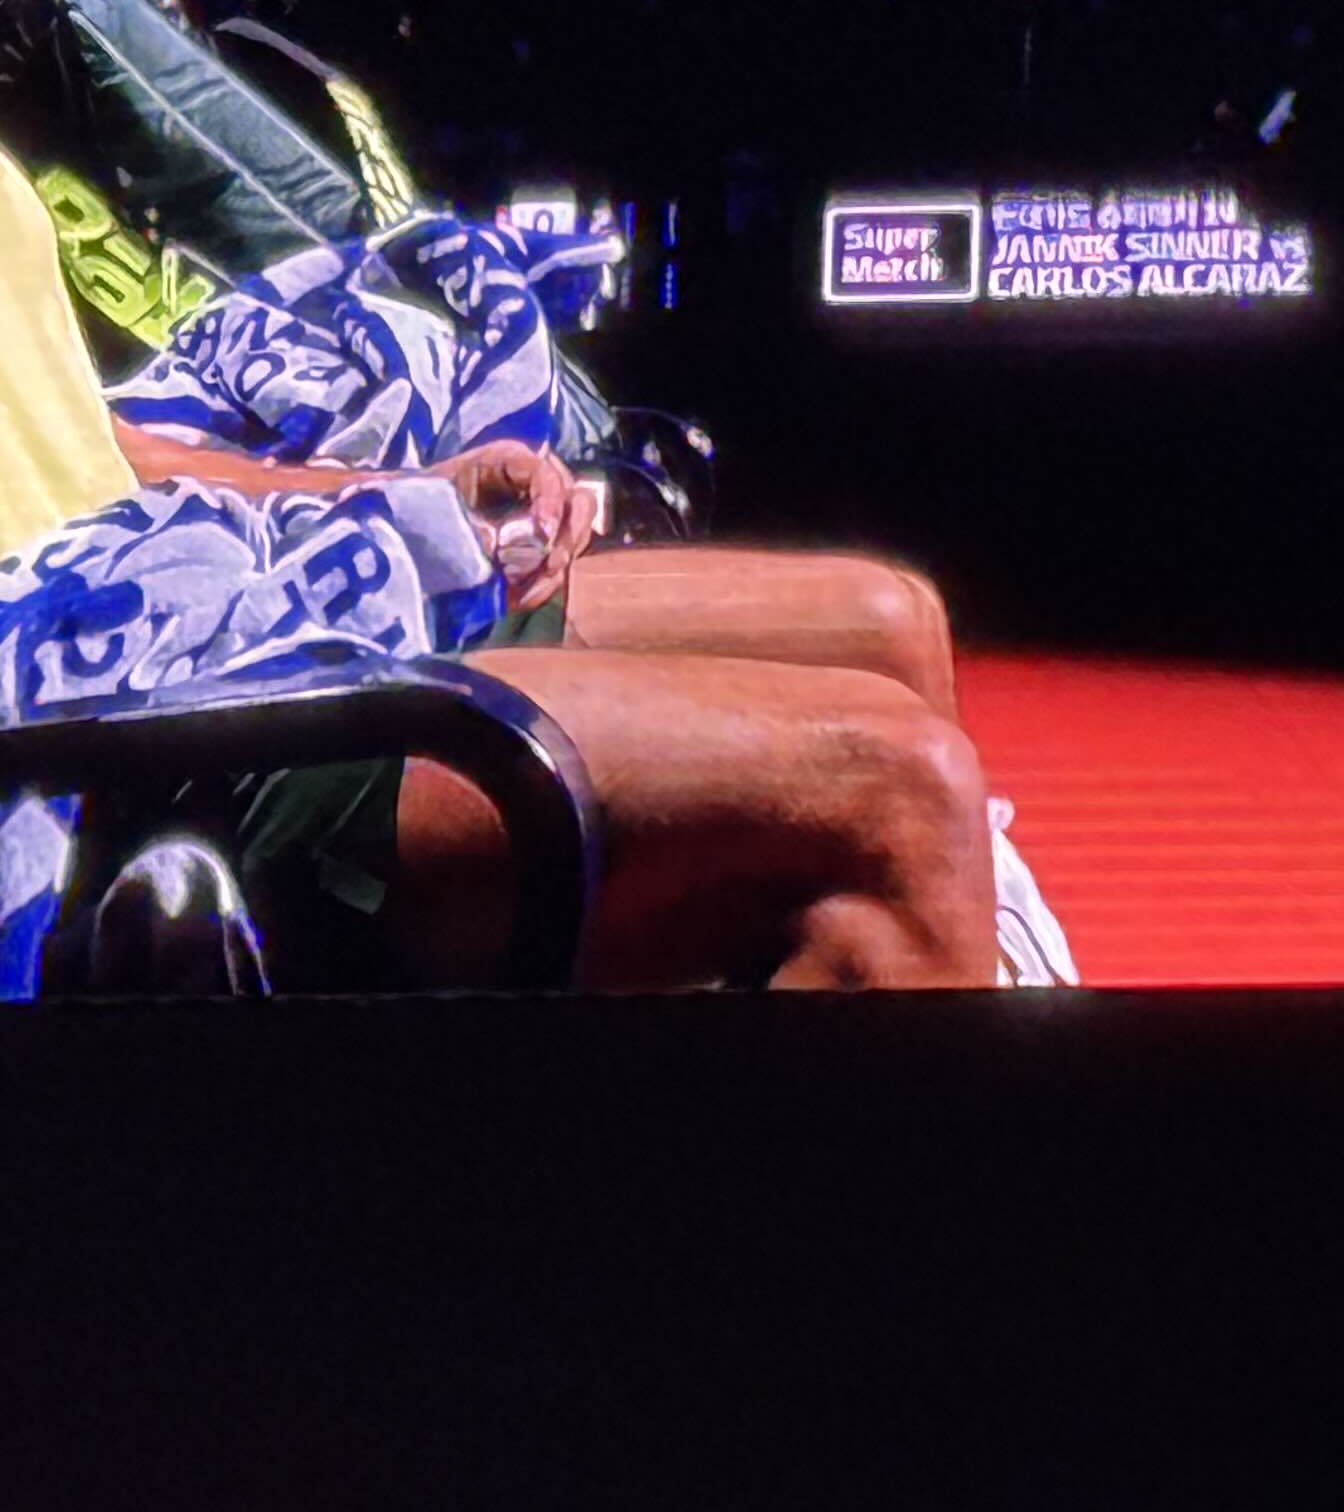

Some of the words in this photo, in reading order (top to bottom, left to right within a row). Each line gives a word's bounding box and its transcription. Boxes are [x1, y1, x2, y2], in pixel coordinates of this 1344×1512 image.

[843, 222, 940, 255] Super
[991, 232, 1120, 265] JANNIK
[987, 263, 1134, 297] CARLOS
[1136, 261, 1311, 295] ALCARAZ
